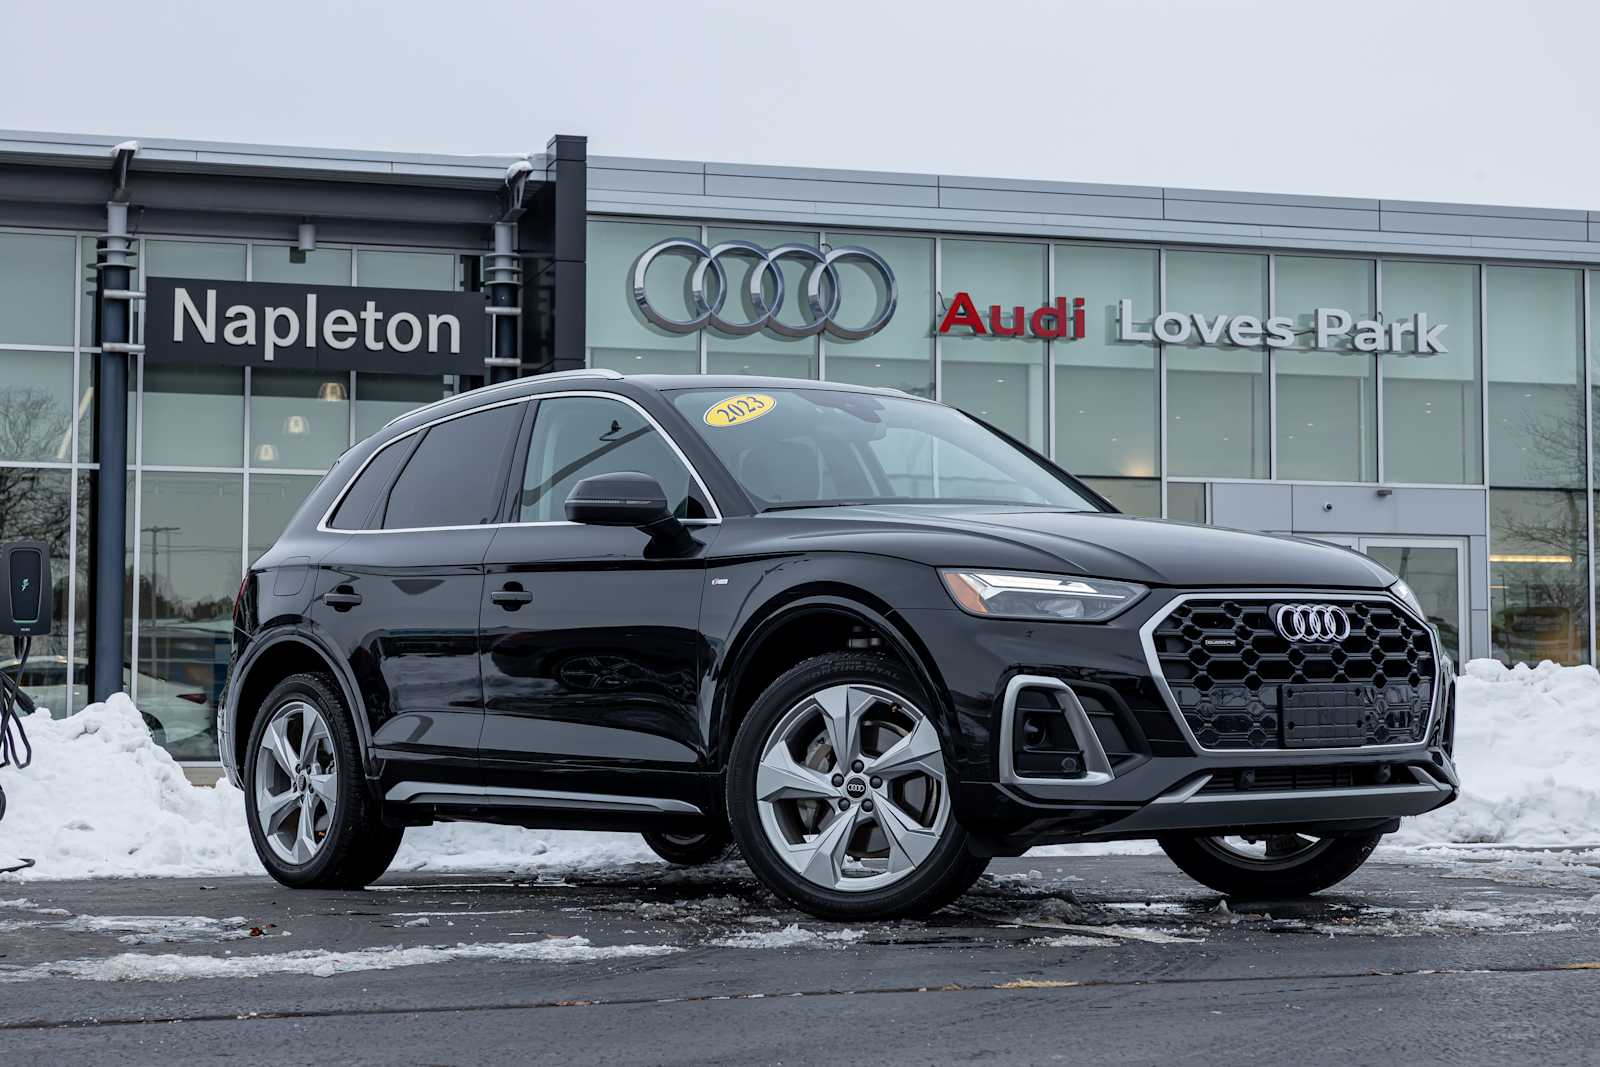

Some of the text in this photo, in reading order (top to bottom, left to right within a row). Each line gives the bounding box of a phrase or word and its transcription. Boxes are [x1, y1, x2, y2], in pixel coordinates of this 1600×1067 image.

[173, 287, 461, 361] Napleton
[938, 291, 1449, 353] Audi Loves Park
[716, 396, 765, 422] 2023
